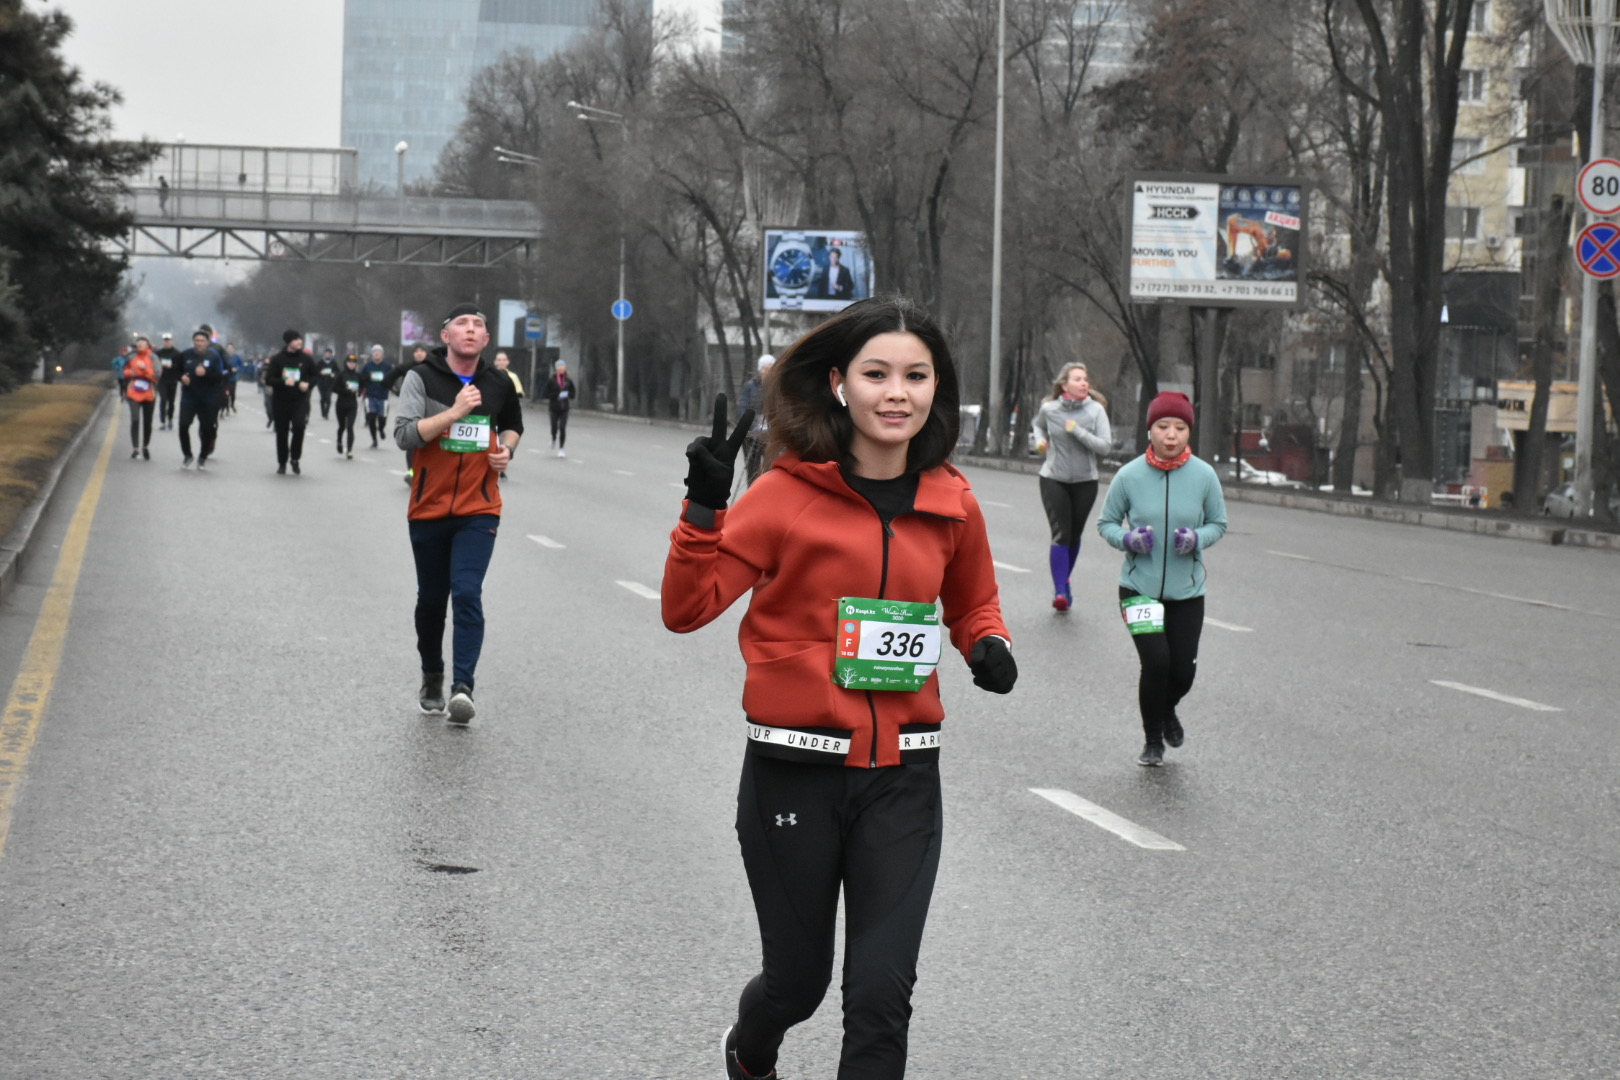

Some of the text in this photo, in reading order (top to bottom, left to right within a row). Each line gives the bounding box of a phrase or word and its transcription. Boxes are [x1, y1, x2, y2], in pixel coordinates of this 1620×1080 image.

[1146, 185, 1195, 195] HYUNDAI
[1592, 176, 1619, 196] 80
[1156, 207, 1189, 218] HCCK
[1132, 247, 1198, 258] MOVING YOU
[1132, 258, 1176, 267] FURTHER
[1135, 283, 1145, 291] +7
[1148, 283, 1170, 292] (727)
[1173, 284, 1188, 292] 380
[1222, 285, 1232, 294] +7
[1235, 286, 1249, 294] 701
[457, 426, 479, 438] 501
[1136, 608, 1151, 619] 75
[845, 638, 852, 647] F
[876, 631, 926, 658] 336
[787, 733, 841, 751] UNDER
